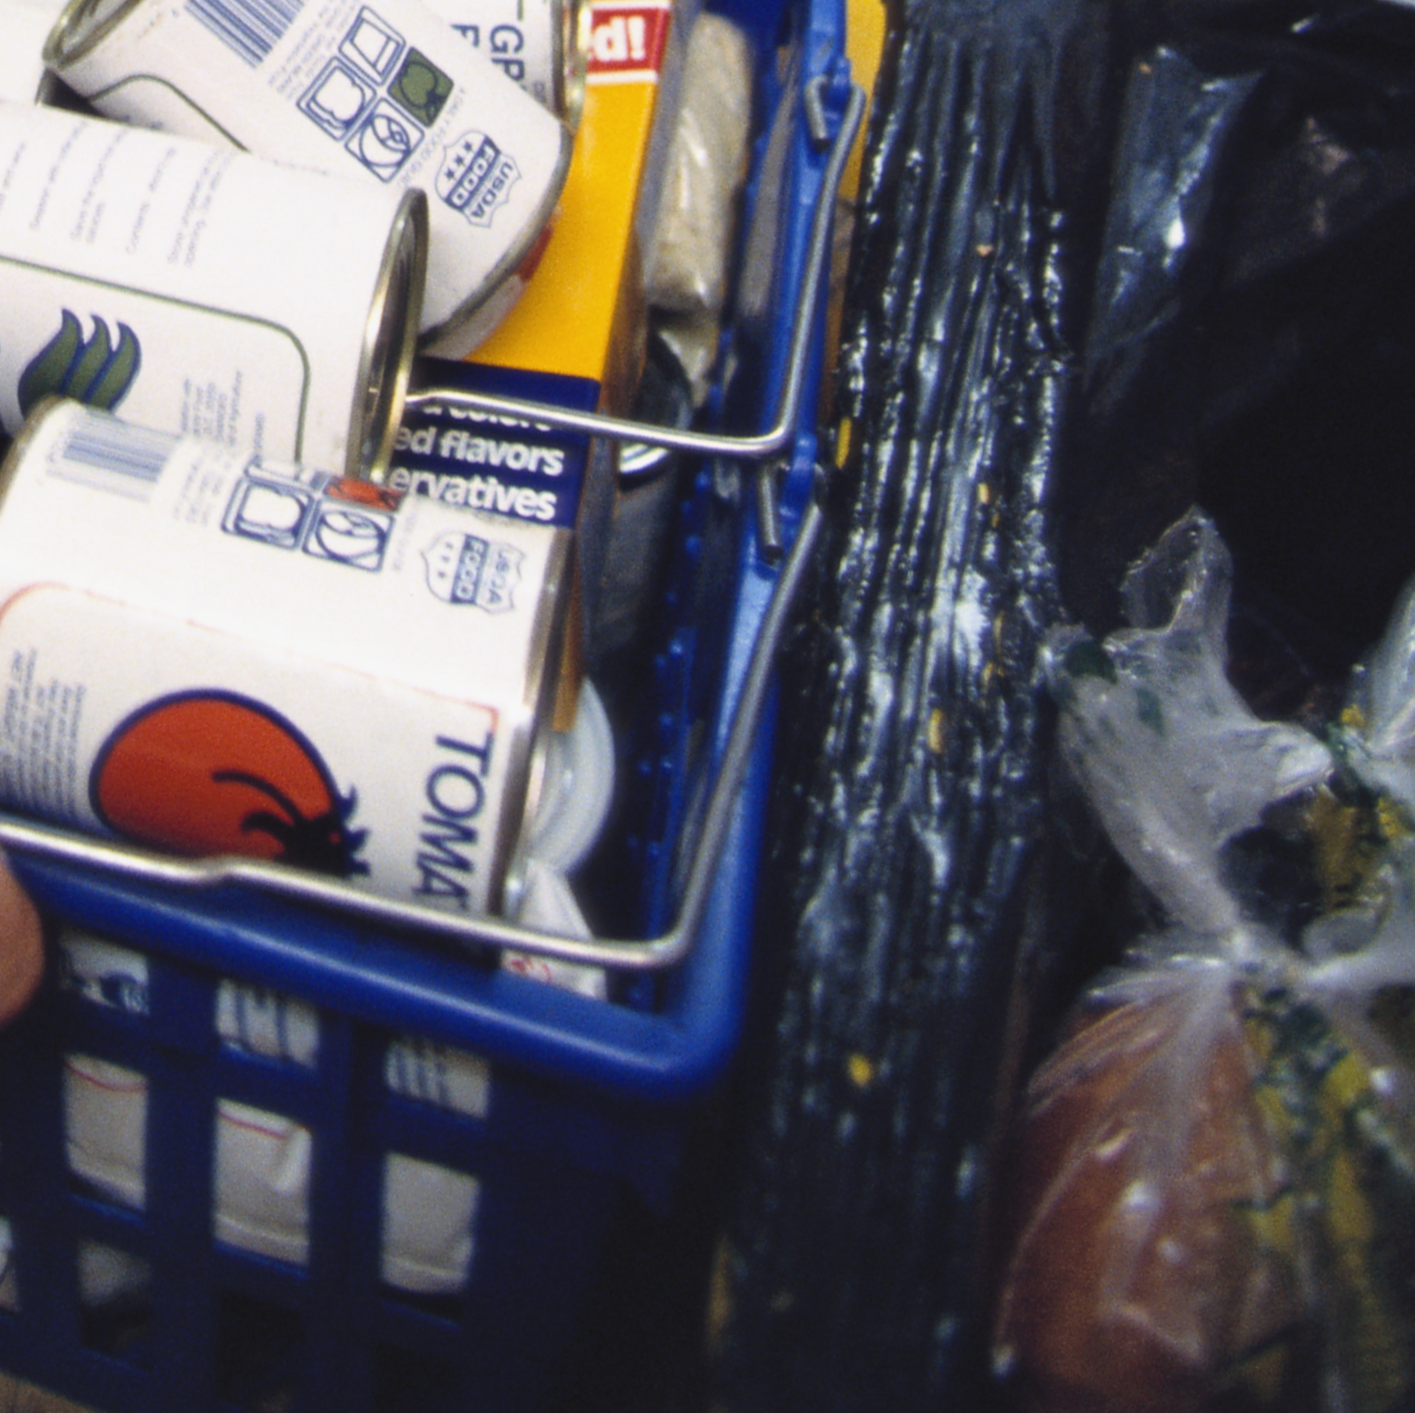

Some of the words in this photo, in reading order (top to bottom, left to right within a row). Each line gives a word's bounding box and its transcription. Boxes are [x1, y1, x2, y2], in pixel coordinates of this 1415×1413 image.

[592, 15, 646, 62] d!
[451, 143, 497, 208] FOOD
[470, 161, 514, 218] USDA
[392, 426, 437, 455] ed
[440, 429, 565, 477] flavors
[389, 467, 558, 521] ervatives
[411, 732, 494, 911] TOMA
